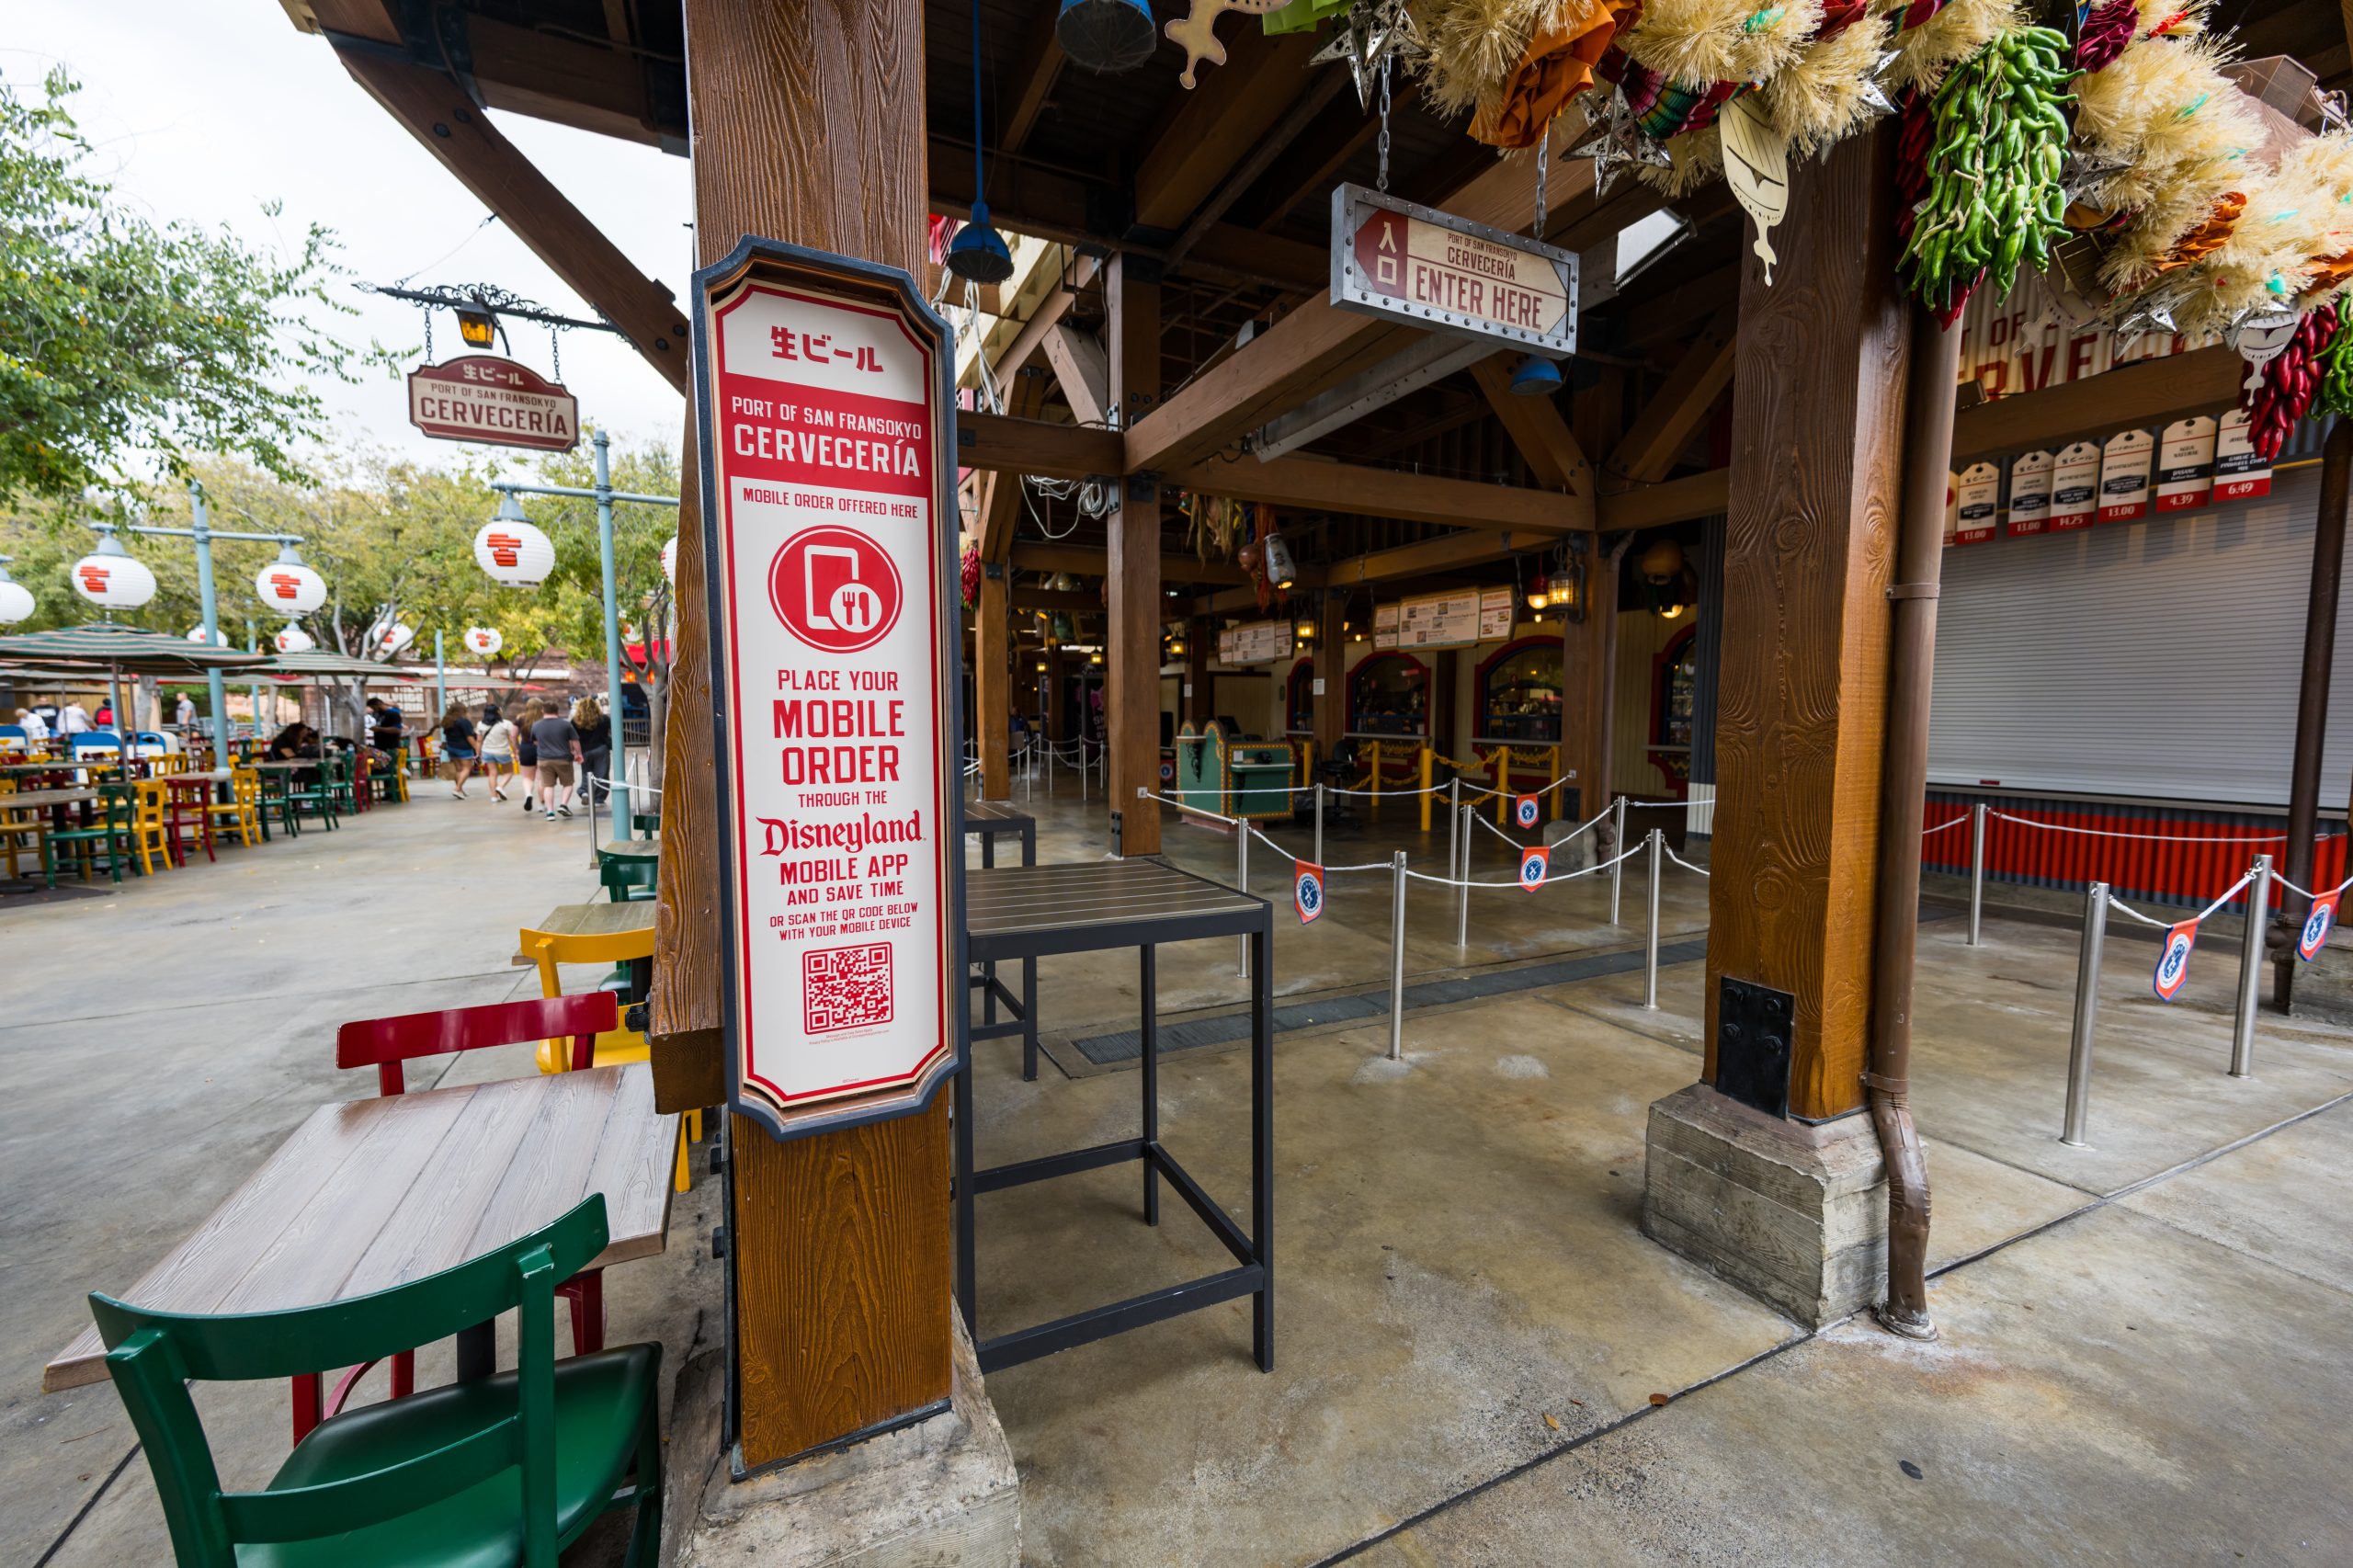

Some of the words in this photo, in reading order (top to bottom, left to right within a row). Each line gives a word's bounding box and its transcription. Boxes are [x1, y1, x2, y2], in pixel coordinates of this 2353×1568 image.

[1448, 233, 1463, 246] PORT
[1464, 237, 1472, 248] OF
[1472, 239, 1484, 252] SAN
[1485, 243, 1517, 262] FRANSOKYO
[1448, 246, 1516, 280] CERVECERÍA
[1415, 265, 1483, 315] ENTER
[1493, 285, 1542, 329] HERE
[1991, 311, 2026, 347] OF
[770, 325, 884, 372] 生ビール
[462, 364, 525, 386] 生ビール
[431, 382, 457, 395] PORT
[461, 387, 472, 396] OF
[477, 389, 496, 401] SAN
[500, 392, 557, 409] FRANSOKYO
[420, 396, 568, 436] CERVECERÍA
[732, 396, 773, 419] PORT
[779, 403, 798, 422] OF
[804, 407, 834, 427] SAN
[839, 412, 922, 439] FRANSOKYO
[734, 423, 921, 477] CERVECERÍA
[743, 487, 790, 506] MOBILE
[794, 493, 834, 510] ORDER
[838, 497, 887, 516] OFFERED
[891, 503, 918, 518] HERE
[2170, 494, 2194, 506] 4.39
[2228, 483, 2254, 494] 6.49
[2109, 506, 2135, 517] 13.00
[778, 669, 840, 690] PLACE
[849, 671, 898, 691] YOUR
[773, 699, 905, 738] MOBILE
[782, 744, 900, 785] ORDER
[798, 791, 859, 808] THROUGH
[865, 790, 888, 804] THE
[755, 809, 924, 857] Disneyland
[779, 857, 858, 885] MOBILE
[868, 854, 908, 878] APP
[787, 888, 819, 906] AND
[826, 884, 863, 902] SAVE
[870, 881, 904, 898] TIME
[769, 915, 784, 927] OR
[788, 912, 816, 926] SCAN
[821, 910, 838, 922] THE
[842, 908, 855, 921] QR
[858, 904, 883, 918] CODE
[887, 902, 918, 915] BELOW
[779, 928, 804, 941] WITH
[809, 925, 836, 938] YOUR
[840, 920, 875, 935] MOBILE
[879, 916, 911, 930] DEVICE
